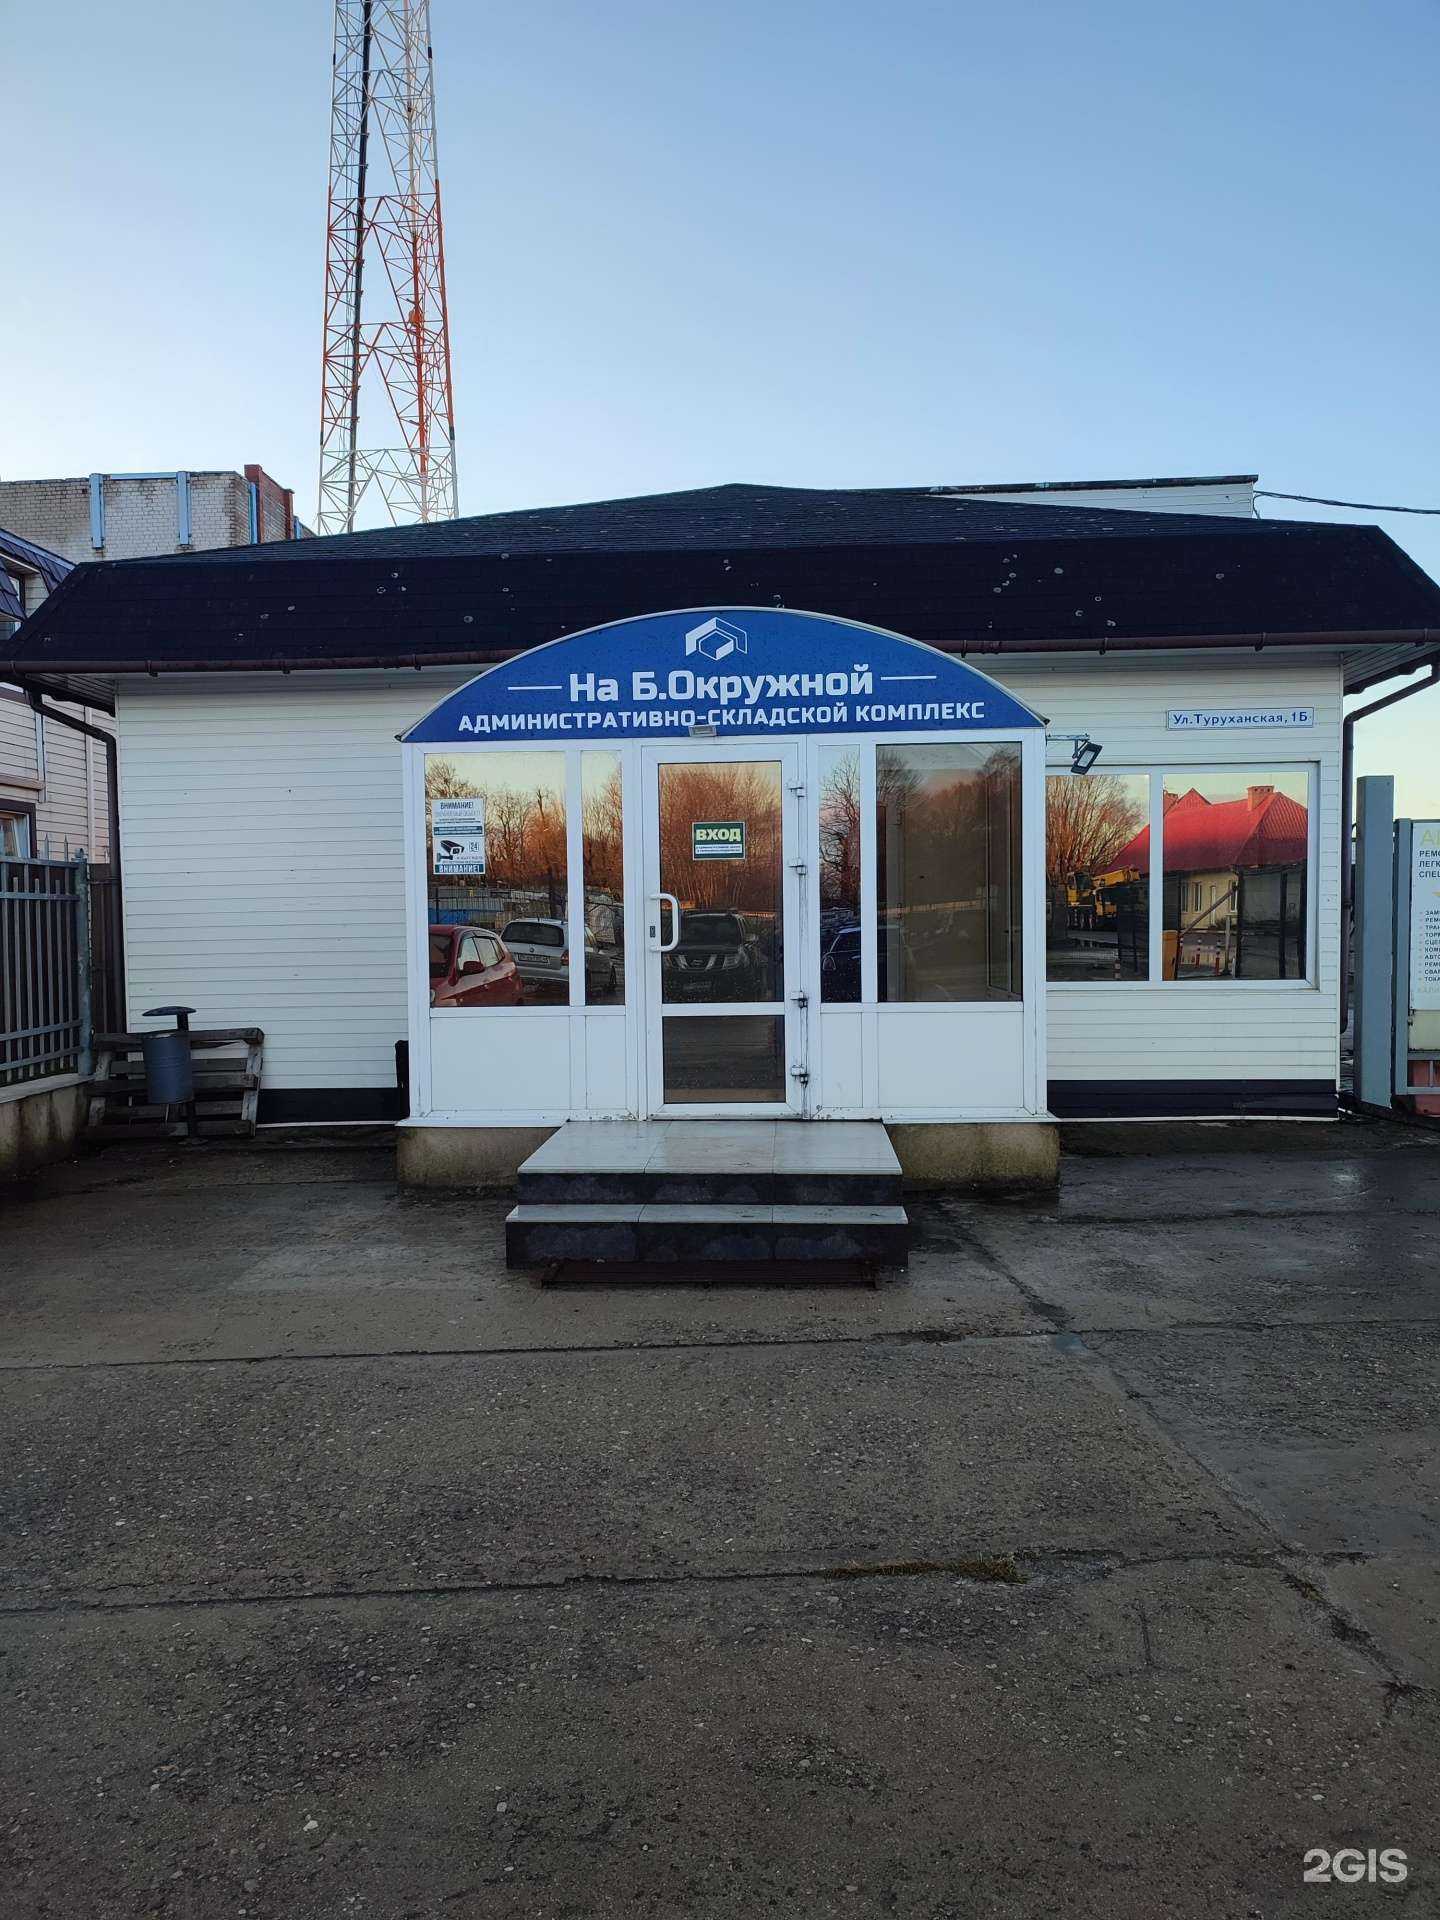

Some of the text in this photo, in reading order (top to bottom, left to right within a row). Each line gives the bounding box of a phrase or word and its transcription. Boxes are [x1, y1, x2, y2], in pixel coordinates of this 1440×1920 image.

[570, 664, 874, 705] На Б.Окружной
[458, 701, 985, 733] АДМИНИСТРАТИВНО-СКЛАДСКОЙ КОМПЛЕКС
[695, 828, 741, 841] ВХОД
[439, 864, 480, 873] ВНИМАНИЕ!
